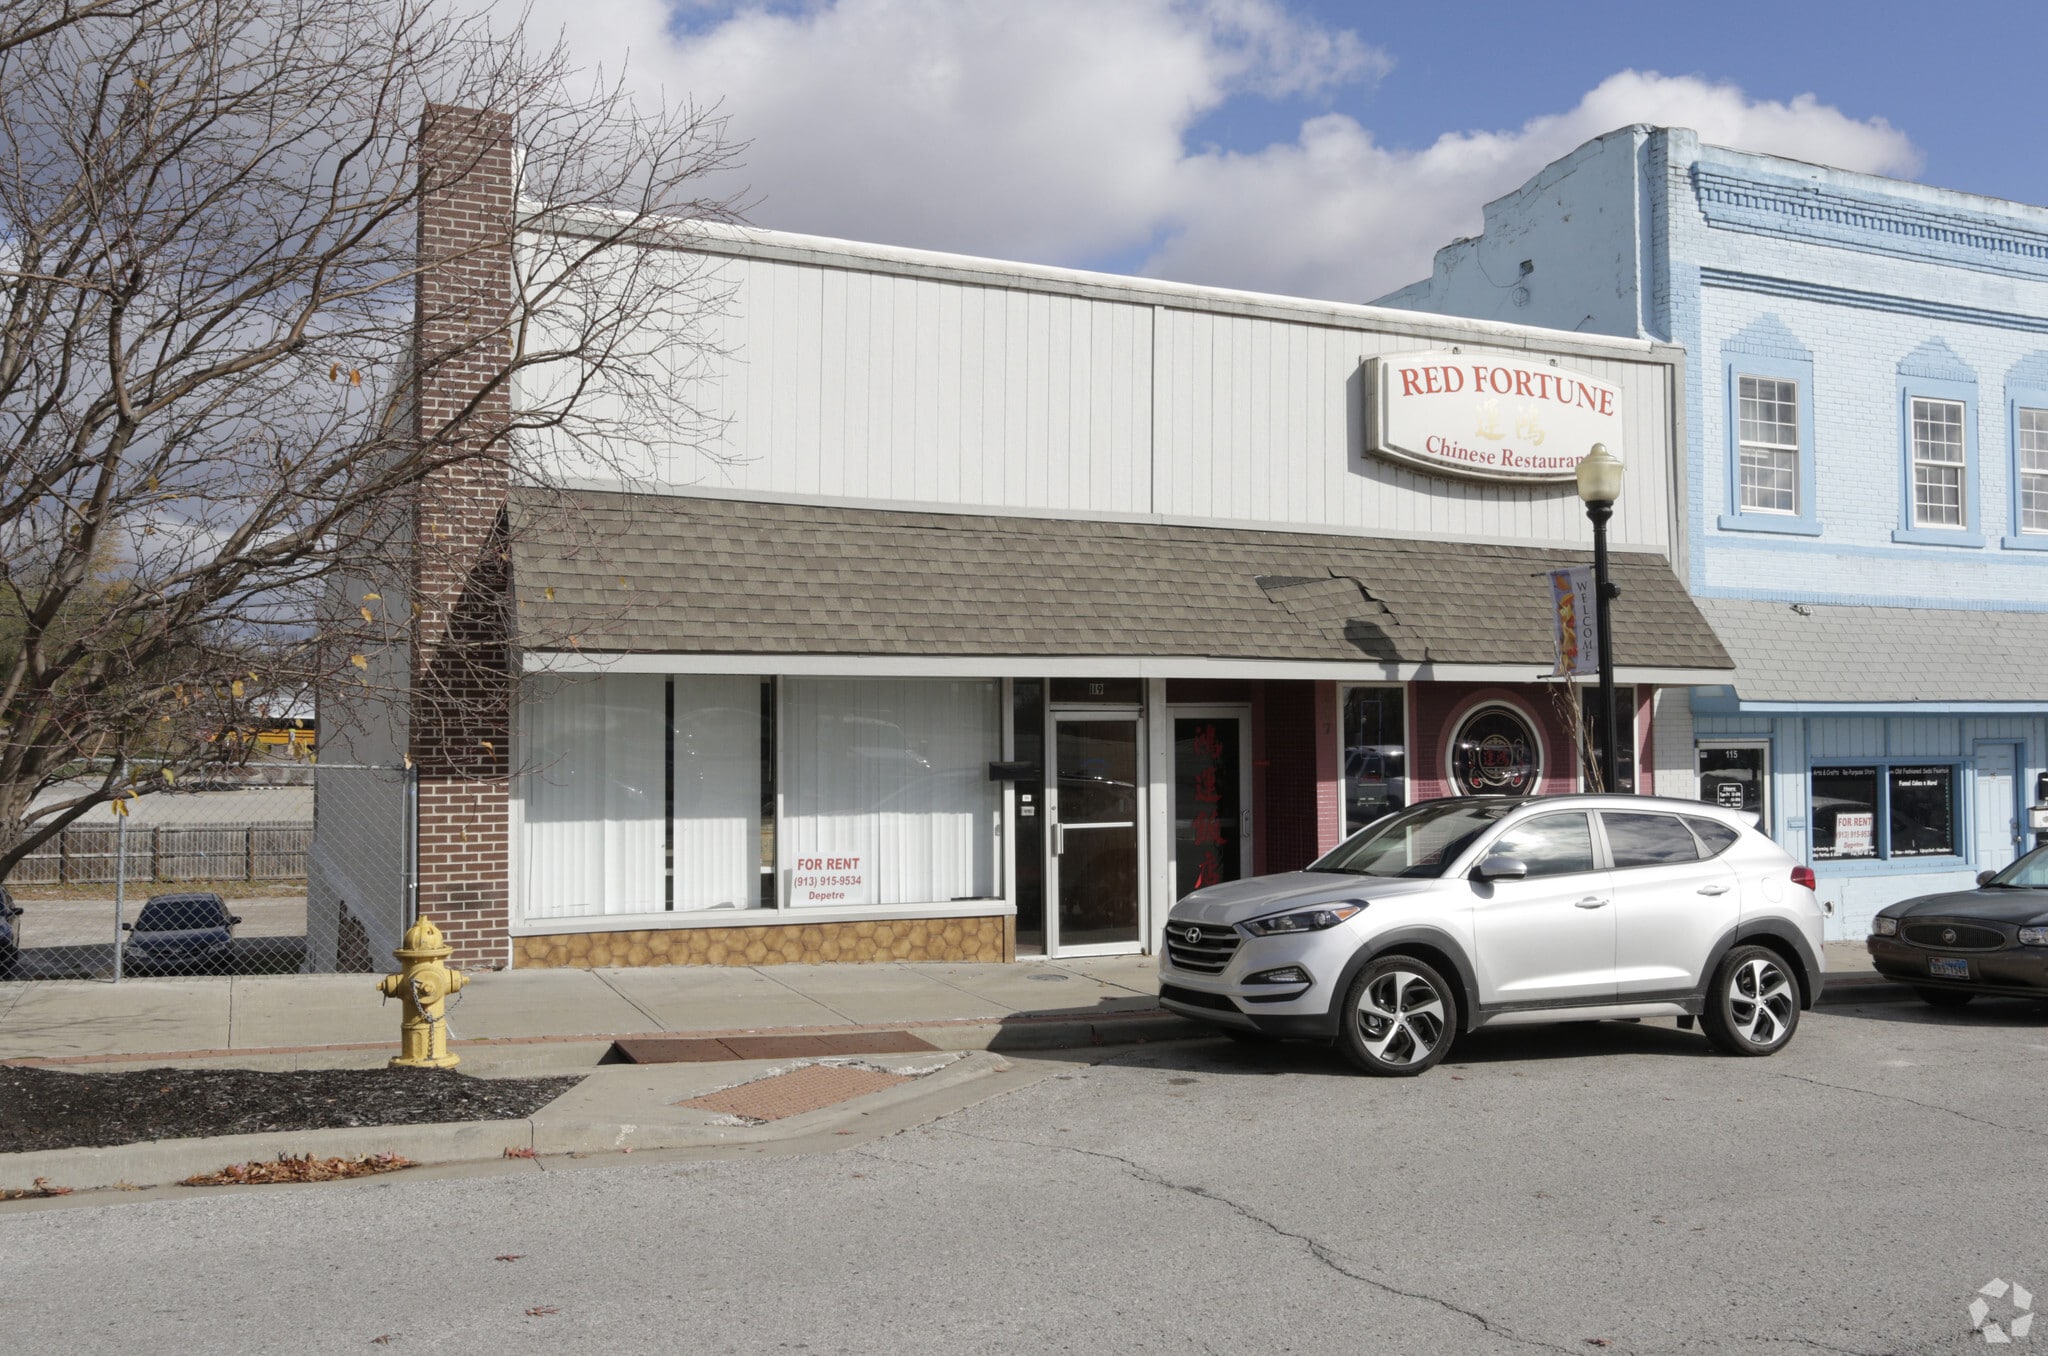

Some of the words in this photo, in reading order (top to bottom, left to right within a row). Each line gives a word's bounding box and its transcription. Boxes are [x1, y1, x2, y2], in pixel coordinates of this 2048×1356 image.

[1398, 365, 1464, 397] RED
[1472, 365, 1614, 417] FORTUNE
[1425, 434, 1496, 465] Chinese
[1500, 448, 1585, 469] Restauran
[1576, 581, 1593, 661] WELCOME
[1725, 750, 1739, 759] 115
[1838, 818, 1852, 827] FOR
[1854, 817, 1872, 826] RENT
[797, 858, 822, 871] FOR
[826, 857, 860, 870] RENT
[794, 876, 818, 889] (913)
[820, 875, 862, 886] 915-9534
[808, 891, 845, 902] Depetre
